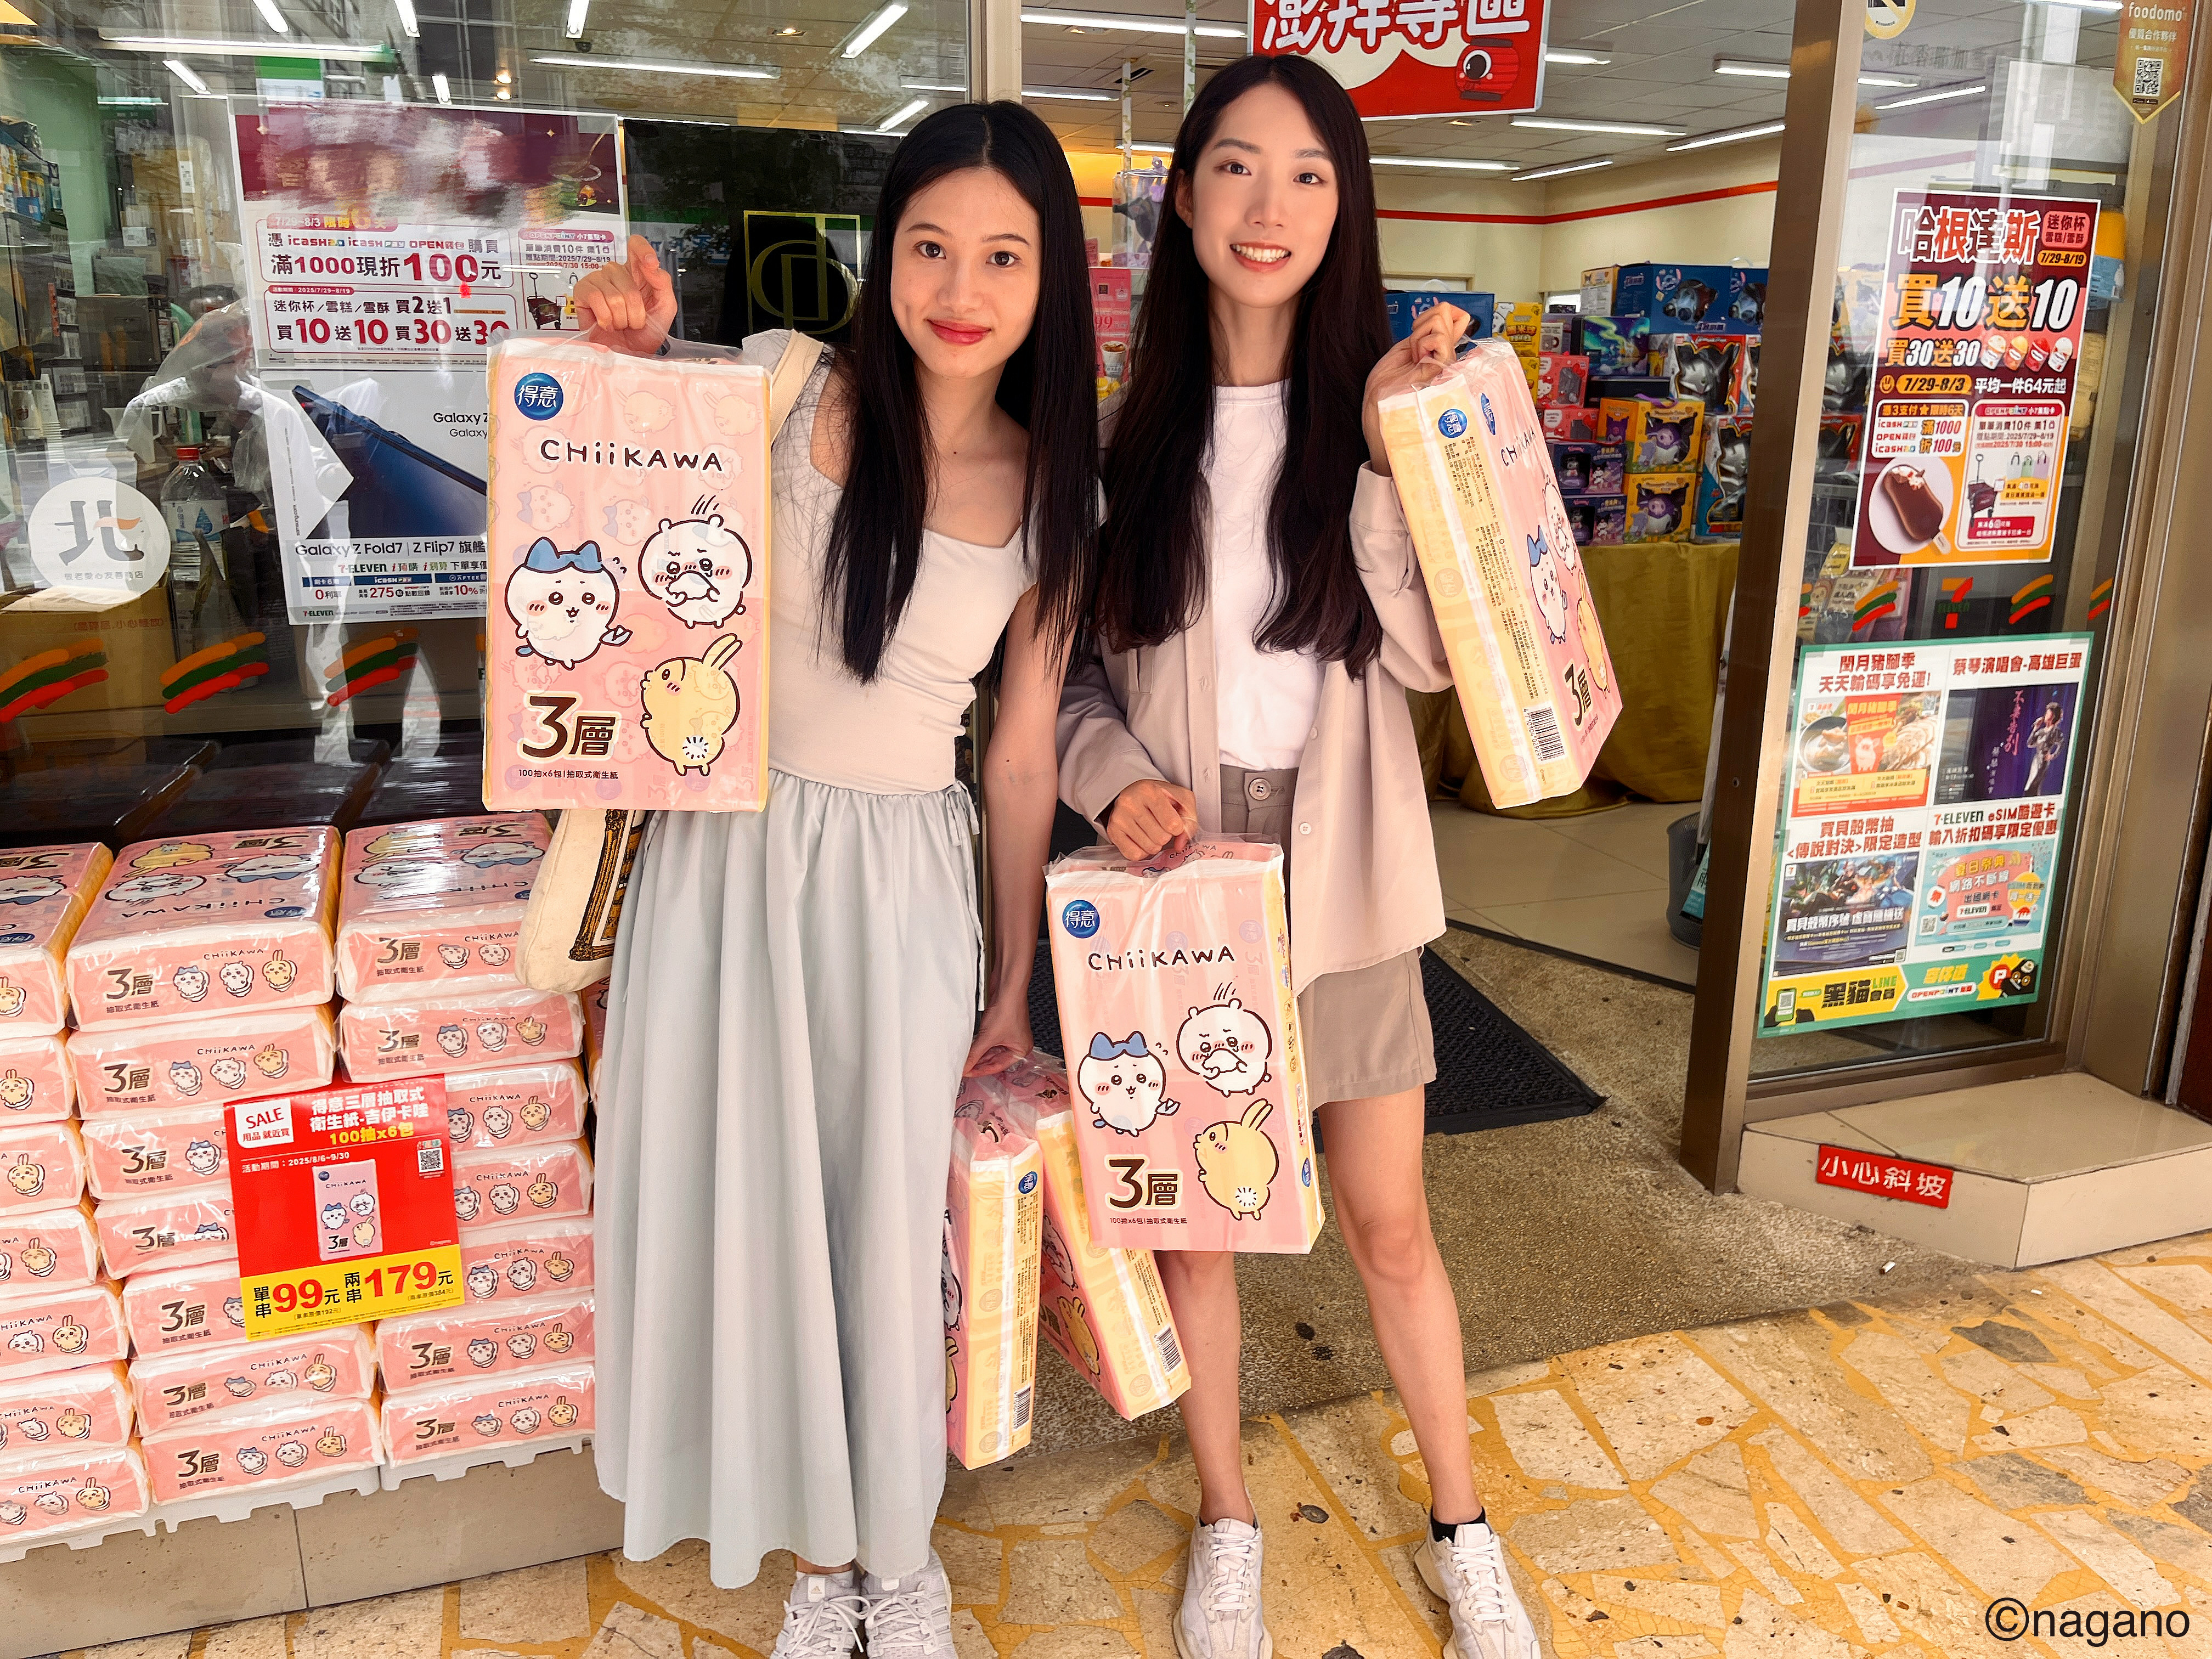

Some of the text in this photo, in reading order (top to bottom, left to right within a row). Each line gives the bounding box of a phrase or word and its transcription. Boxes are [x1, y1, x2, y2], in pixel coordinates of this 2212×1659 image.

[2129, 2, 2182, 21] foodomo
[468, 239, 499, 253] 購買
[1897, 206, 2086, 265] 哈根達斯 迷你杯
[271, 252, 501, 283] 滿1000現折100元
[2040, 252, 2084, 264] 7/29-8/19
[1891, 273, 2078, 330] 買10送10
[1884, 338, 1980, 368] 買30送30
[517, 382, 558, 409] 得意
[1903, 377, 1965, 391] 7/29-8/3
[1974, 377, 2067, 394] 平均一件64元起
[433, 412, 481, 424] Galaxy
[449, 428, 487, 438] Galaxy
[295, 544, 349, 558] Galaxy
[353, 543, 362, 554] Z
[365, 542, 403, 554] Fold7
[413, 542, 421, 552] Z
[425, 541, 454, 556] Flip7
[370, 588, 394, 599] 275
[454, 585, 478, 596] 10%
[522, 696, 616, 758] 3層
[1065, 910, 1096, 929] 得意
[377, 937, 420, 963] 3層
[106, 968, 154, 1000] 3層
[1872, 975, 1898, 988] LINE
[377, 1029, 420, 1053] 3層
[104, 1063, 151, 1093] 3層
[311, 1086, 425, 1115] 得意三層抽取式
[245, 1107, 285, 1130] SALE
[330, 1122, 414, 1146] 100抽x6包
[122, 1146, 167, 1173] 3層
[1109, 1159, 1176, 1207] 3層
[1820, 1155, 1946, 1199] 小心斜坡
[132, 1227, 176, 1250] 3層
[161, 1301, 206, 1331] 3層
[410, 1343, 450, 1370] 3層
[163, 1383, 207, 1406] 3層
[416, 1419, 456, 1442] 3層
[178, 1449, 220, 1478] 3層
